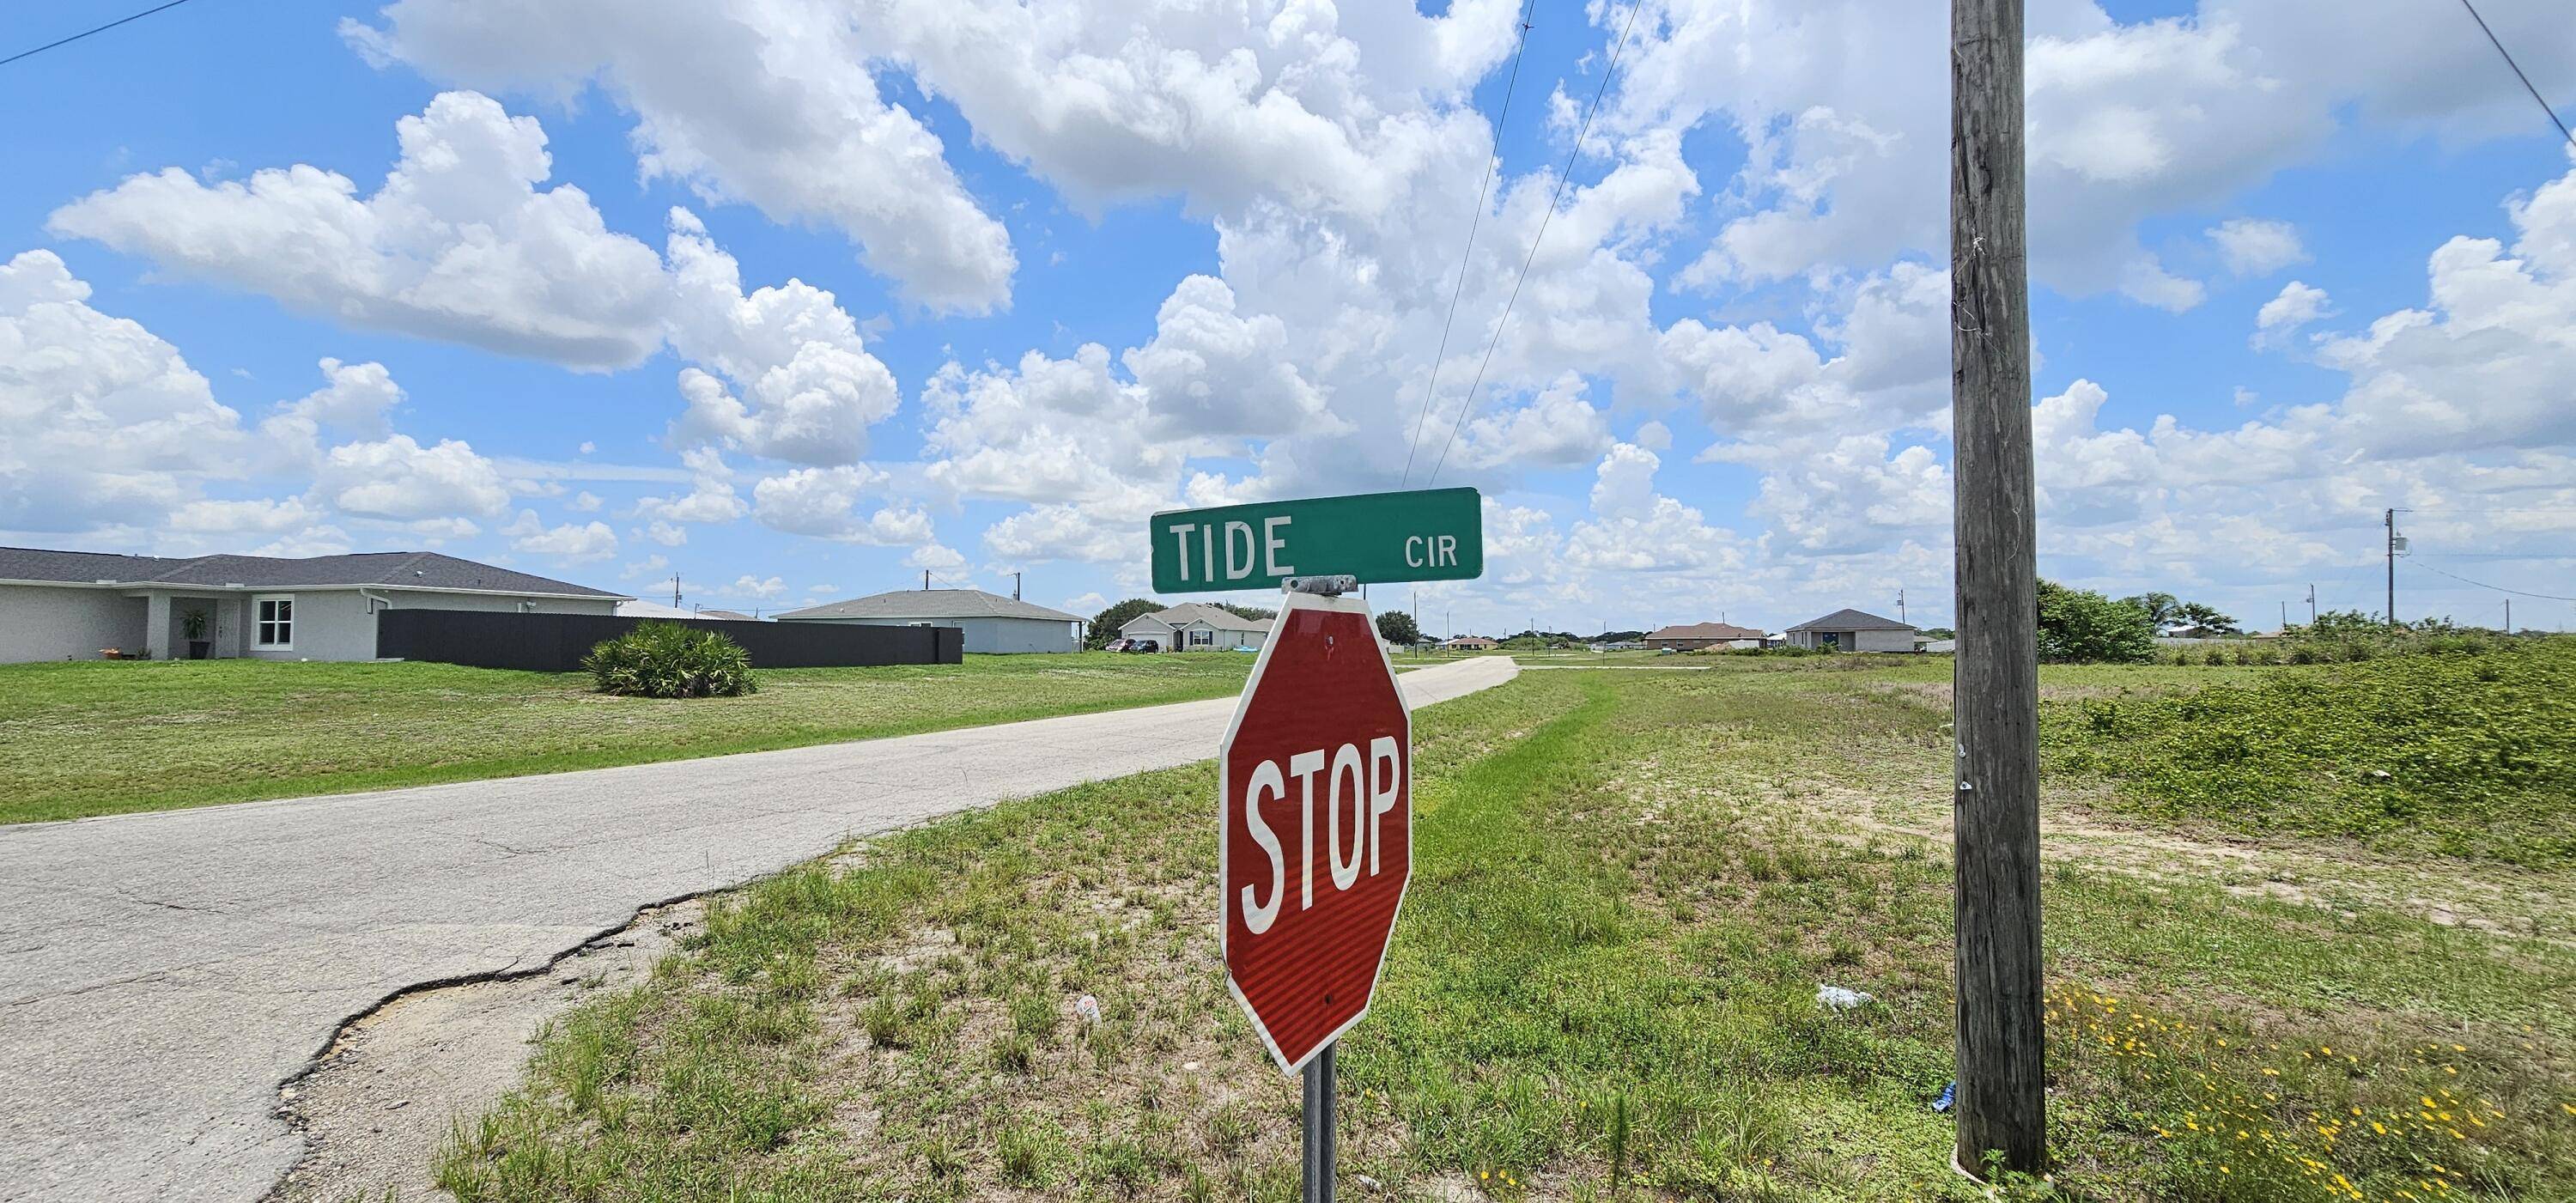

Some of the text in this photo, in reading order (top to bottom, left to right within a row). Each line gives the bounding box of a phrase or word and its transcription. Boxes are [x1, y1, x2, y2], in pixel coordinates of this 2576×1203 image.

[1169, 515, 1457, 582] TIDE CIR
[1241, 735, 1400, 935] STOP
